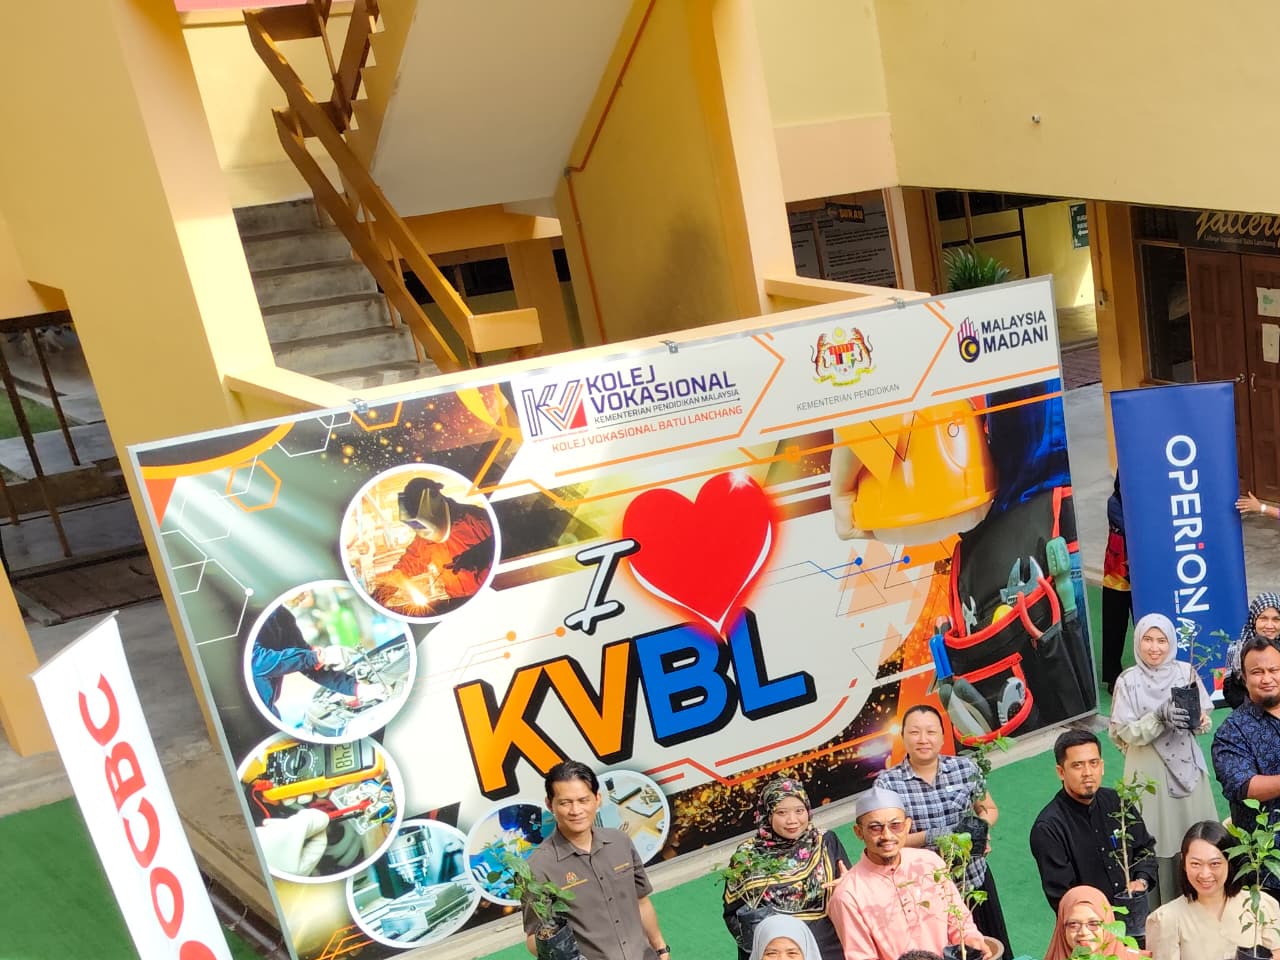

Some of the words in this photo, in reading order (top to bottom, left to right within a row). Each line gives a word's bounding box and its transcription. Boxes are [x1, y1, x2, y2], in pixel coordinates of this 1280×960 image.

[981, 310, 1046, 334] MALAYSIA
[983, 325, 1048, 353] MADANI
[586, 365, 656, 395] KOLEJ
[590, 371, 736, 414] VOKASIONAL
[796, 393, 852, 412] KEMENTERIAN
[854, 383, 900, 400] PENDIDIKAN
[594, 405, 651, 424] KEMENTERIAN
[653, 396, 700, 413] PENDIDIKAN
[701, 389, 739, 405] MALAYSIA
[552, 435, 586, 453] KOLEJ
[588, 423, 657, 445] VOKASIONAL
[659, 417, 686, 431] BATU
[688, 405, 743, 425] LANCHANG
[564, 538, 641, 636] I
[454, 607, 818, 800] KVBL
[79, 673, 184, 939] OCBC
